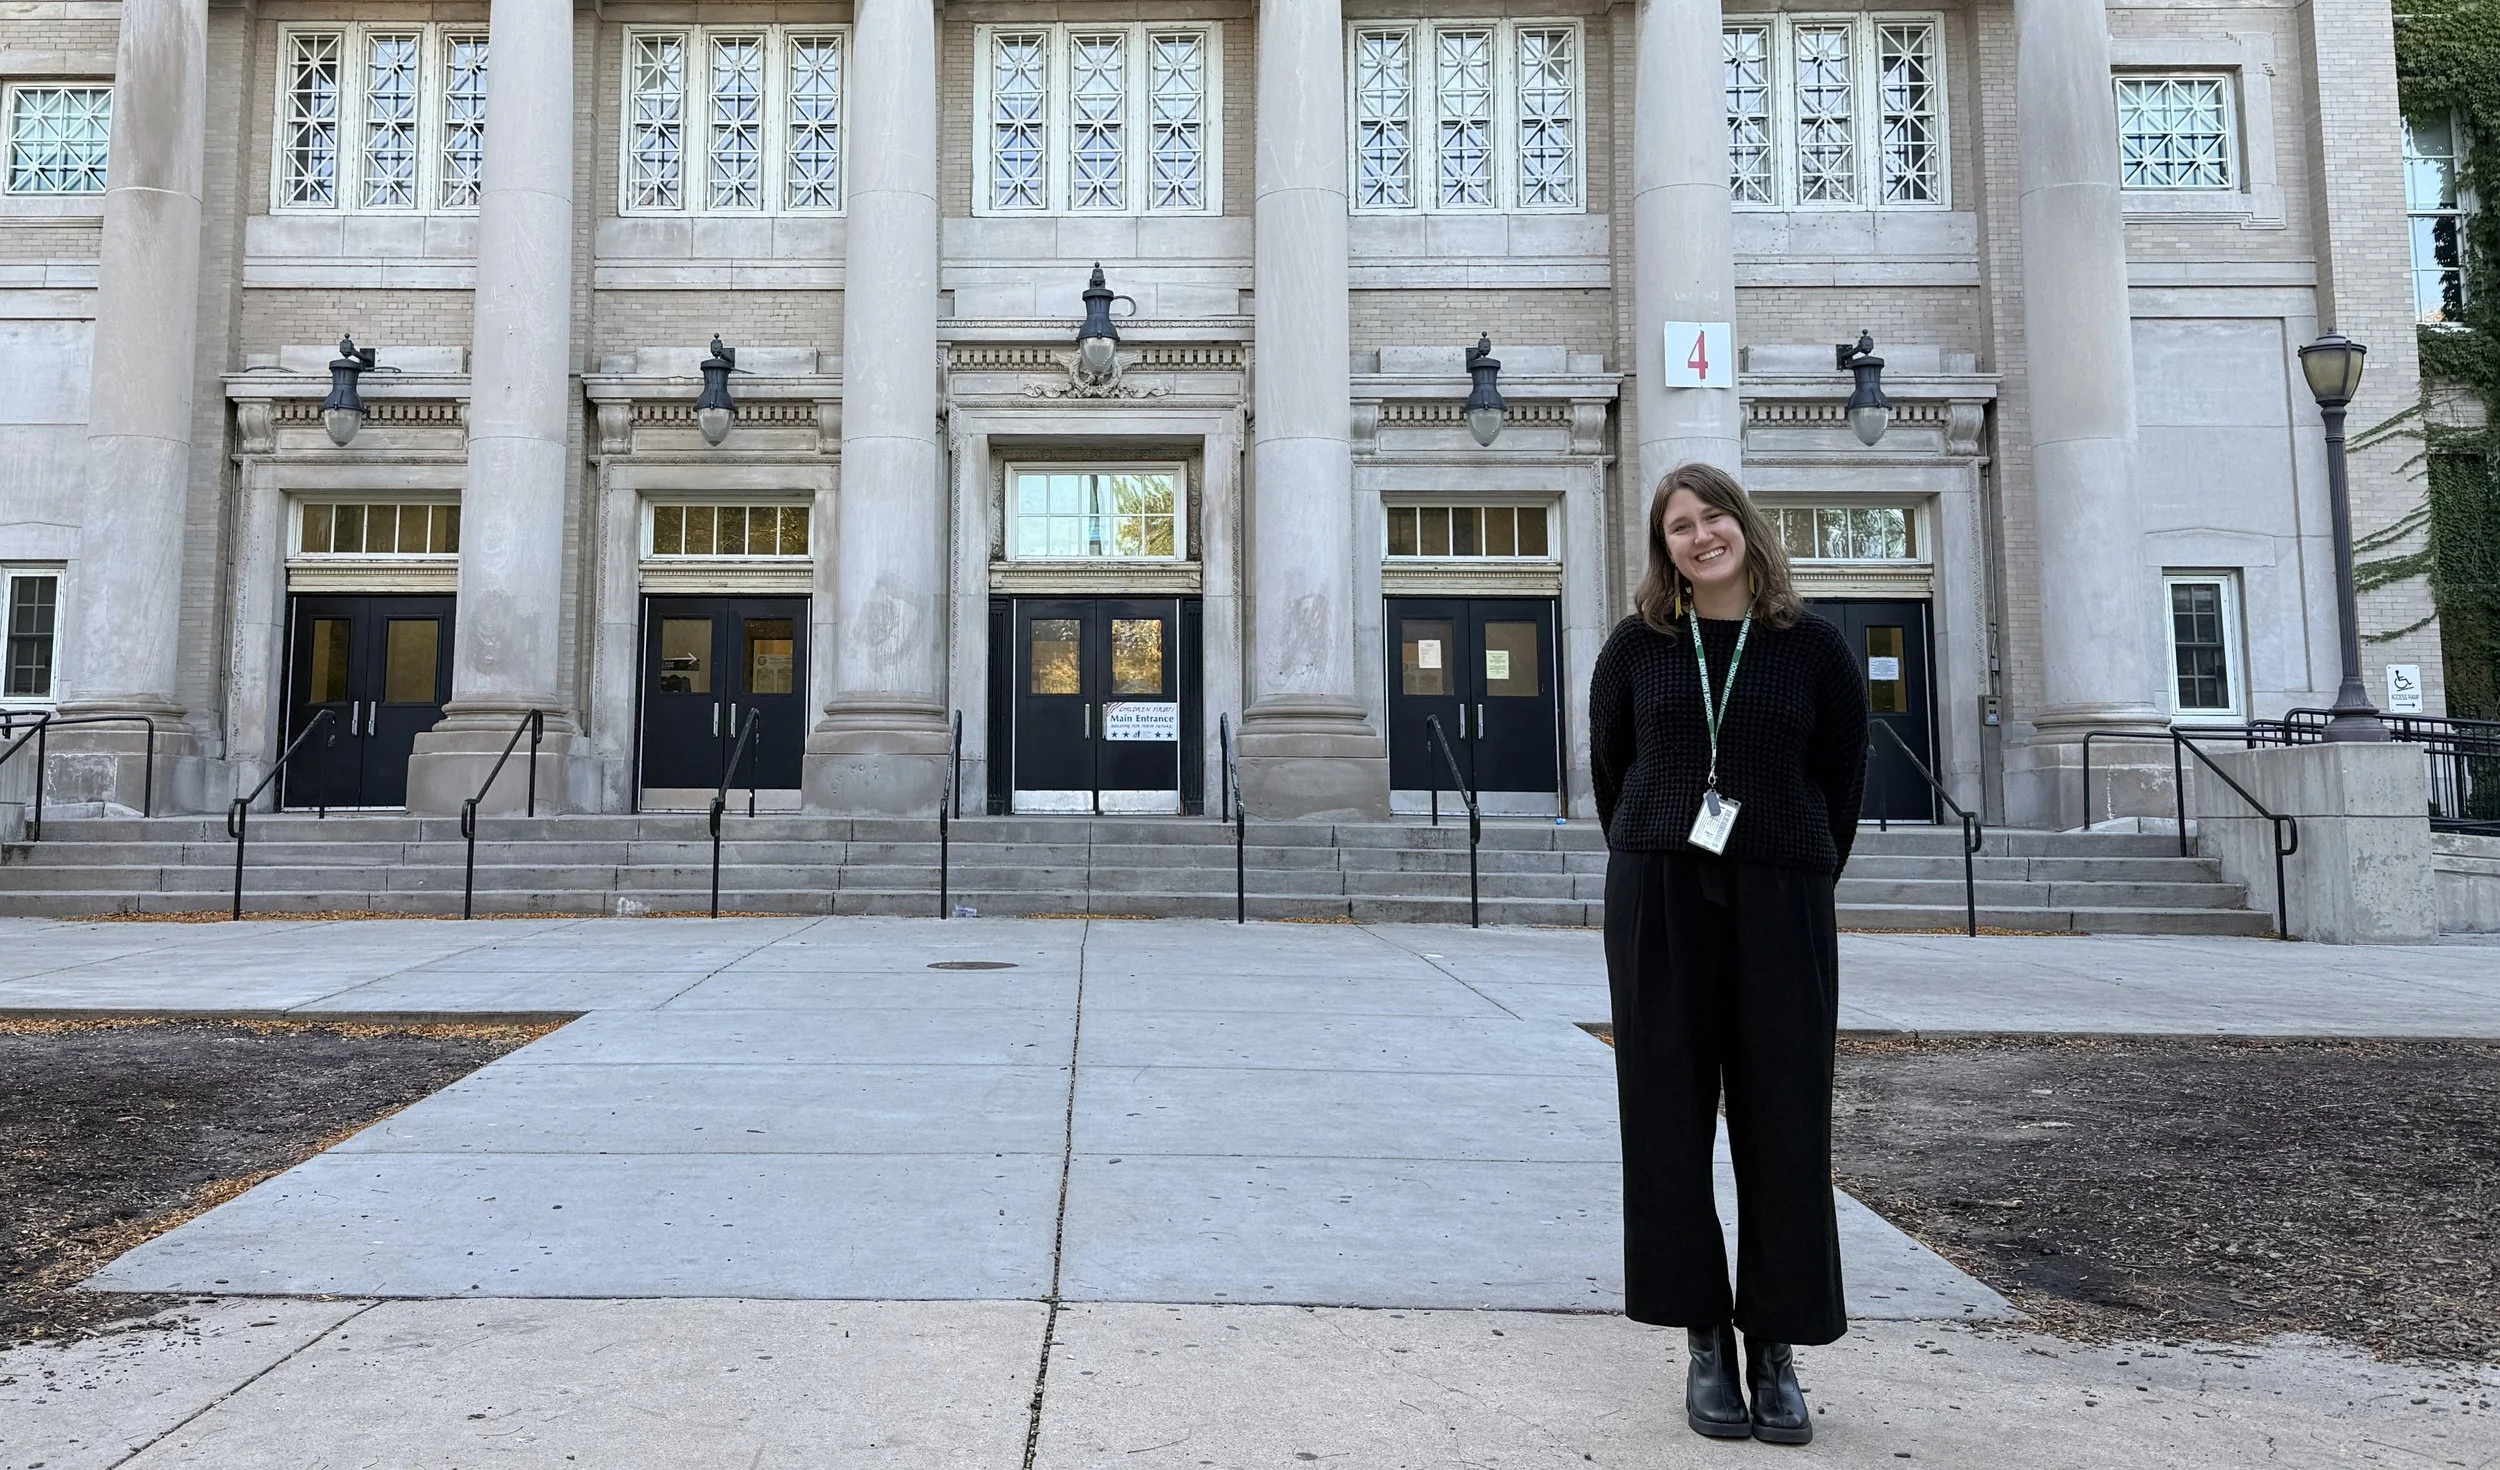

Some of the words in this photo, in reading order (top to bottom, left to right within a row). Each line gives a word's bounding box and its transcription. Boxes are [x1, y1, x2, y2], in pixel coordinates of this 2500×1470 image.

[1687, 330, 1709, 380] 4
[1691, 622, 1701, 648] SCHOOL
[1701, 675, 1710, 692] HIGH
[1725, 661, 1738, 688] SCHOOL
[1110, 714, 1132, 722] Main
[1136, 714, 1174, 722] Entrance
[1704, 692, 1713, 721] SCHOOL
